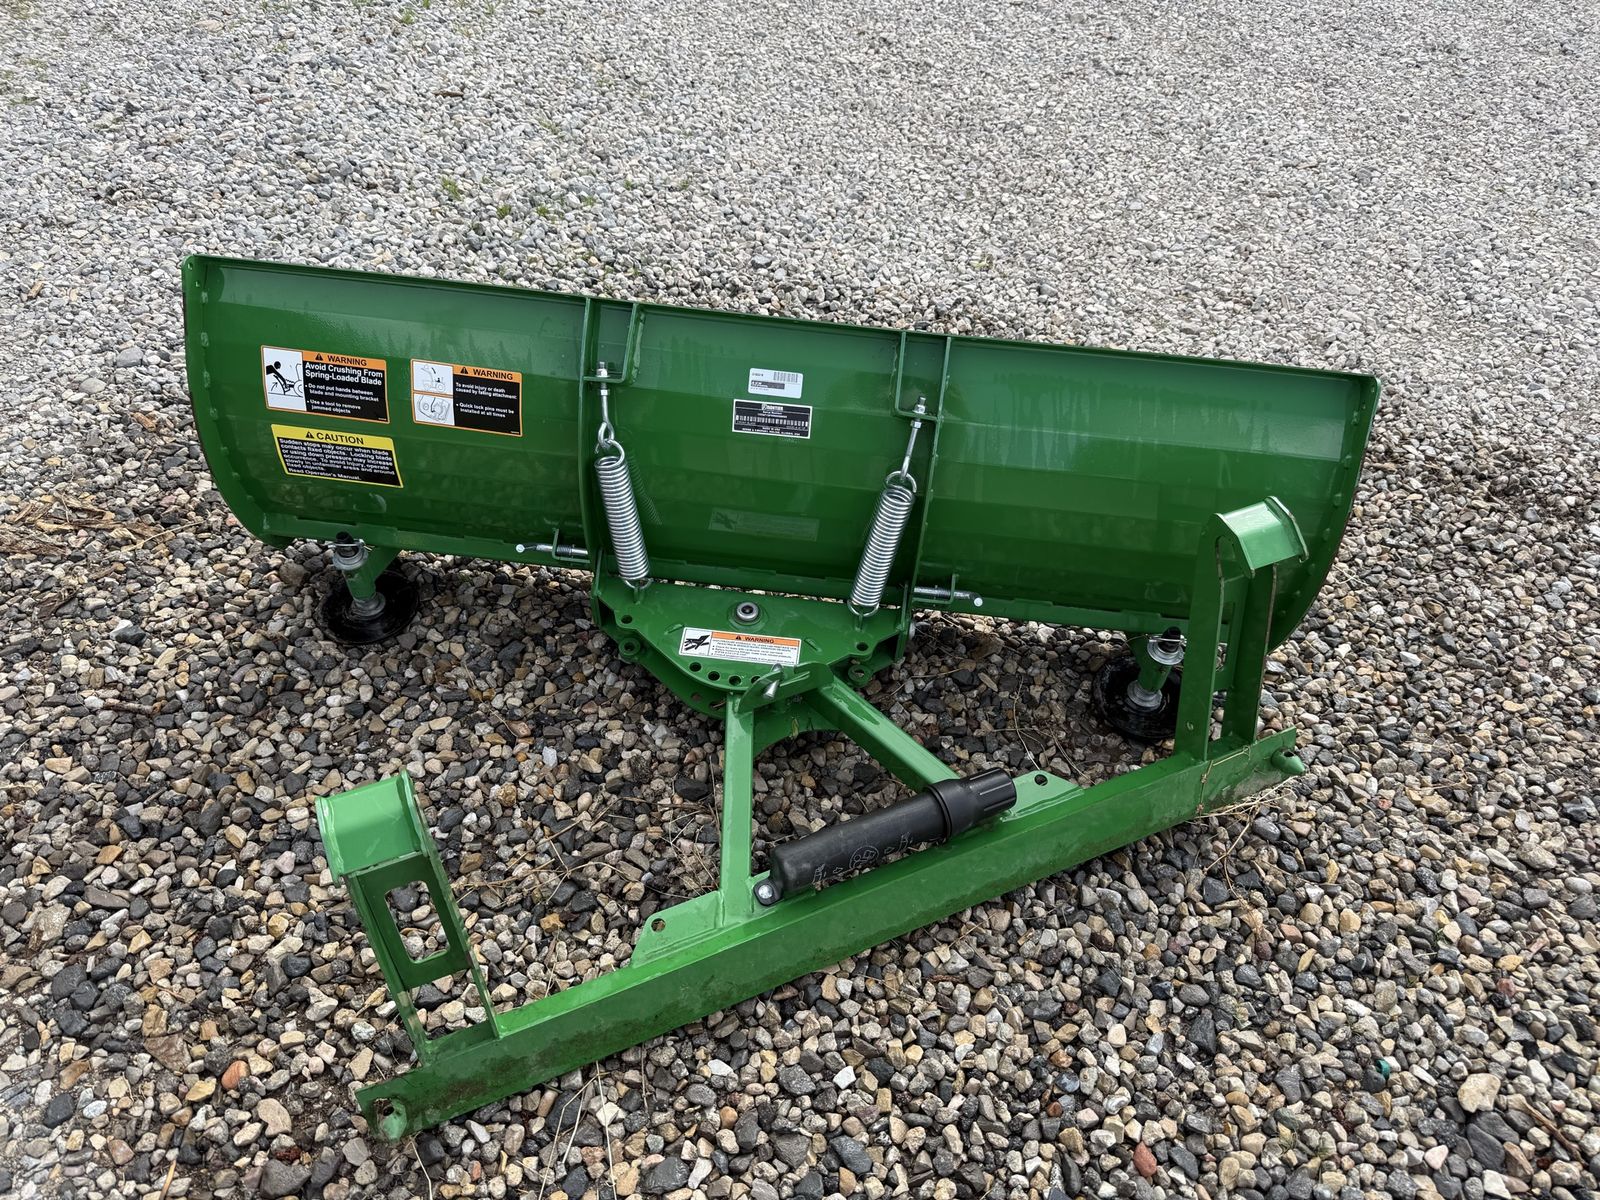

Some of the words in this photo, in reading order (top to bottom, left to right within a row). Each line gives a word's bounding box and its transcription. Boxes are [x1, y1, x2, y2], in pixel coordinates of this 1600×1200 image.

[328, 355, 367, 366] WARNING
[305, 362, 326, 371] Avoid
[328, 365, 362, 376] Crushing
[473, 369, 513, 380] WARNING
[305, 370, 359, 382] Spring-Loaded
[361, 377, 382, 386] Blade
[316, 433, 364, 444] CAUTION
